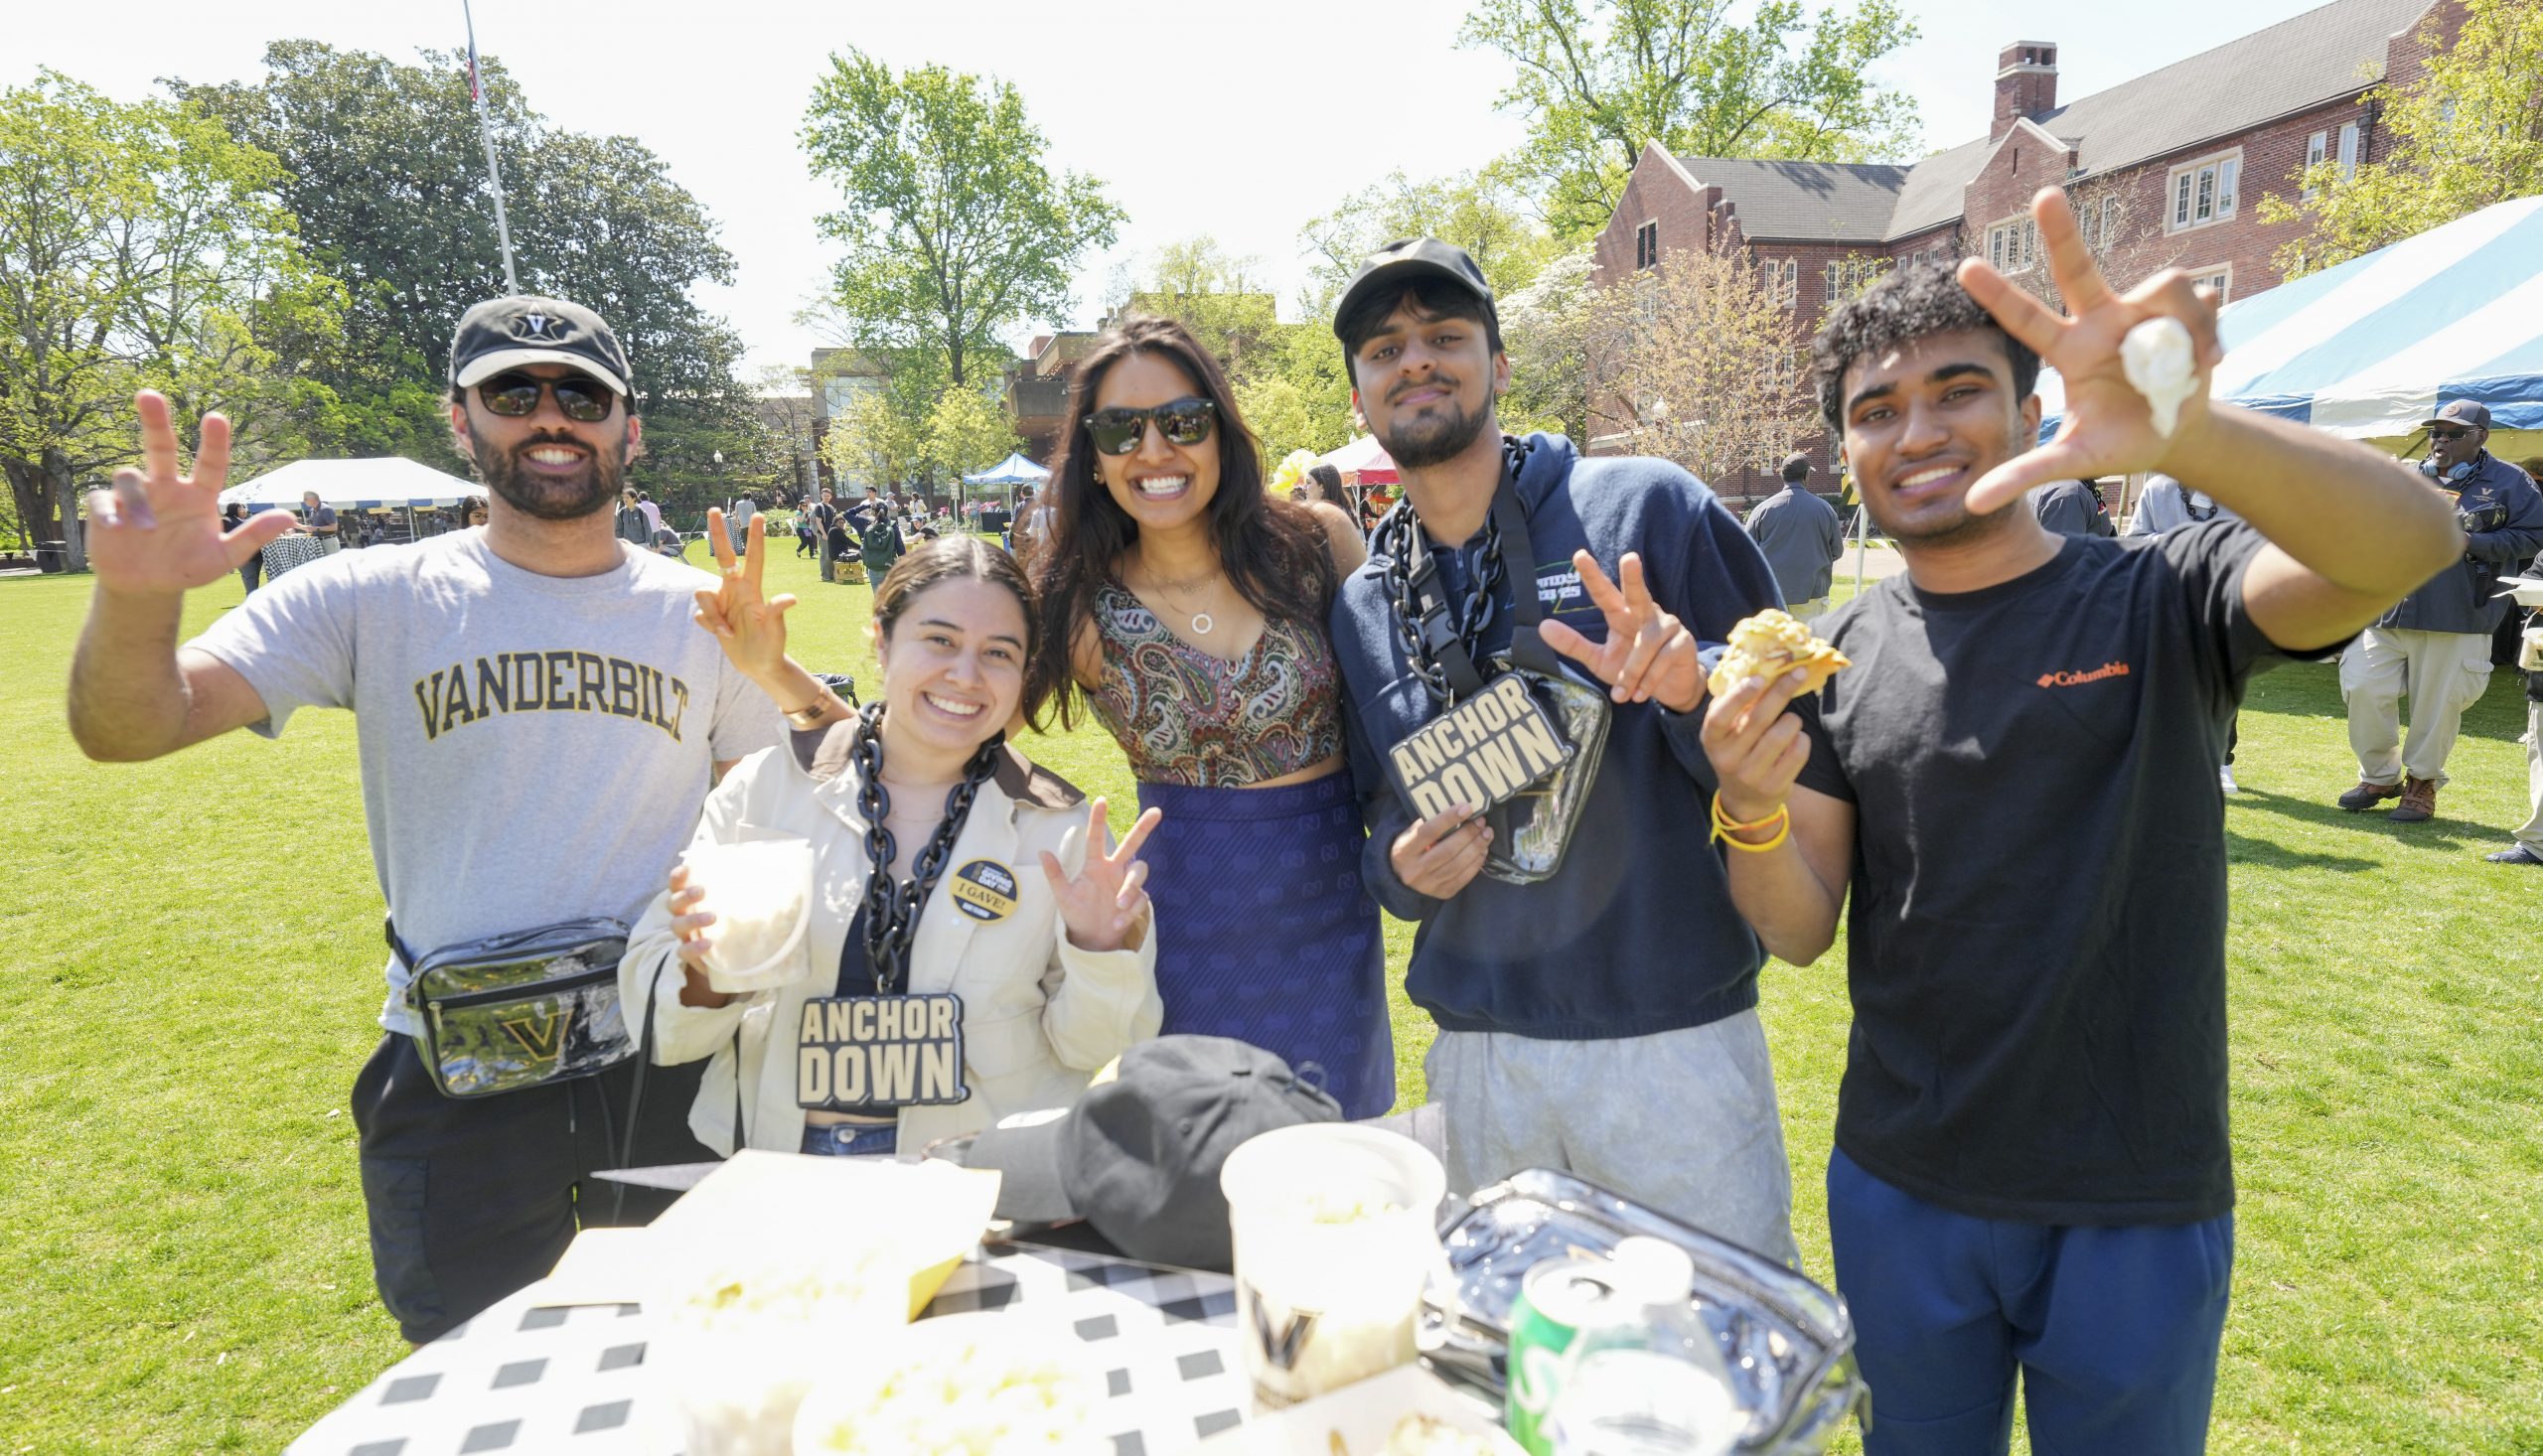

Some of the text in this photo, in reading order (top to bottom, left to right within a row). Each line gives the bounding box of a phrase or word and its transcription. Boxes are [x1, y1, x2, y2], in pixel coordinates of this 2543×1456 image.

[526, 315, 545, 333] V
[414, 651, 688, 743] VANDERBILT
[2054, 660, 2130, 686] Columbia
[1393, 677, 1533, 788] ANCHOR
[1411, 713, 1564, 821] DOWN
[967, 887, 1006, 910] GAVE!
[503, 1008, 573, 1063] V
[801, 996, 954, 1043] ANCHOR
[799, 1042, 955, 1103] DOWN
